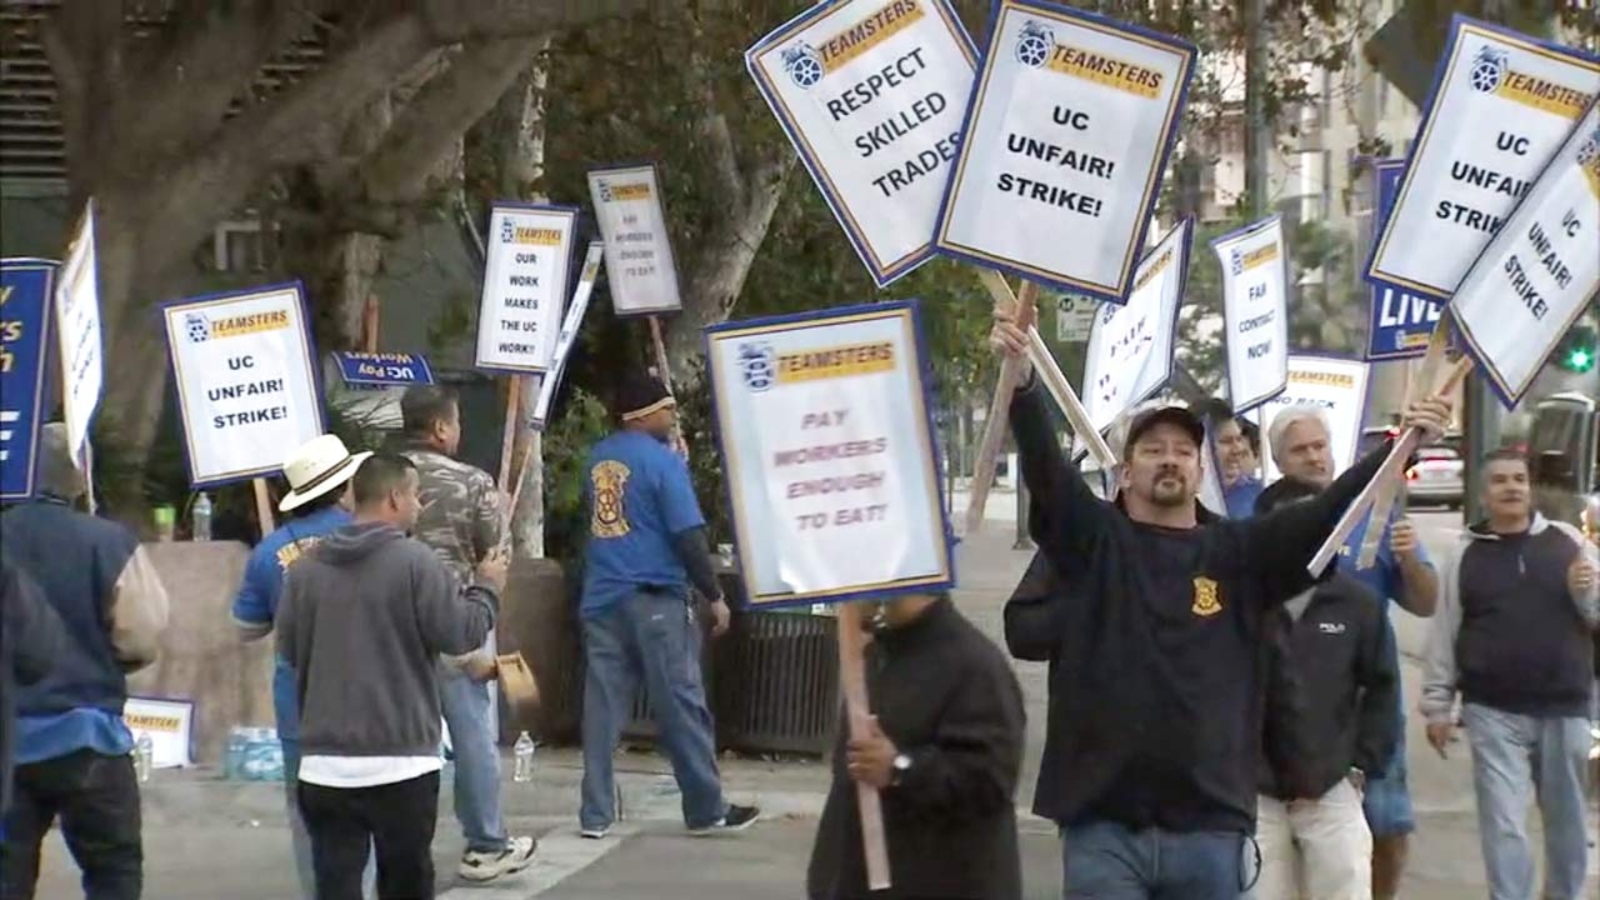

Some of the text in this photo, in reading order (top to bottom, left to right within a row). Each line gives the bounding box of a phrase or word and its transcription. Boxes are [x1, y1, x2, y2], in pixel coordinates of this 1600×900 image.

[1054, 45, 1163, 89] TEAMSTERS
[827, 47, 927, 121] RESPECT
[855, 91, 947, 157] SKILLED
[1053, 106, 1090, 130] UC
[1007, 133, 1115, 179] UNFAIR!
[1496, 131, 1530, 156] UC
[872, 132, 961, 198] TRADES
[1450, 161, 1531, 199] UNFAI
[997, 173, 1103, 216] STRIKE!
[1561, 207, 1581, 238] UC
[515, 253, 537, 264] OUR
[1528, 222, 1573, 290] UNFAIR!
[510, 276, 539, 287] WORK
[1504, 254, 1548, 320] STRIKE!
[504, 298, 538, 310] MAKES
[211, 310, 288, 332] TEAMSTERS
[500, 320, 537, 332] THE UC
[228, 355, 254, 371] UC
[358, 363, 386, 378] Pay
[778, 343, 893, 372] TEAMSTERS
[207, 378, 284, 401] UNFAIR!
[213, 406, 288, 429] STRIKE!
[801, 410, 848, 430] PAY
[774, 438, 887, 467] WORKERS
[787, 472, 886, 499] ENOUGH
[797, 504, 888, 530] TO EAT!
